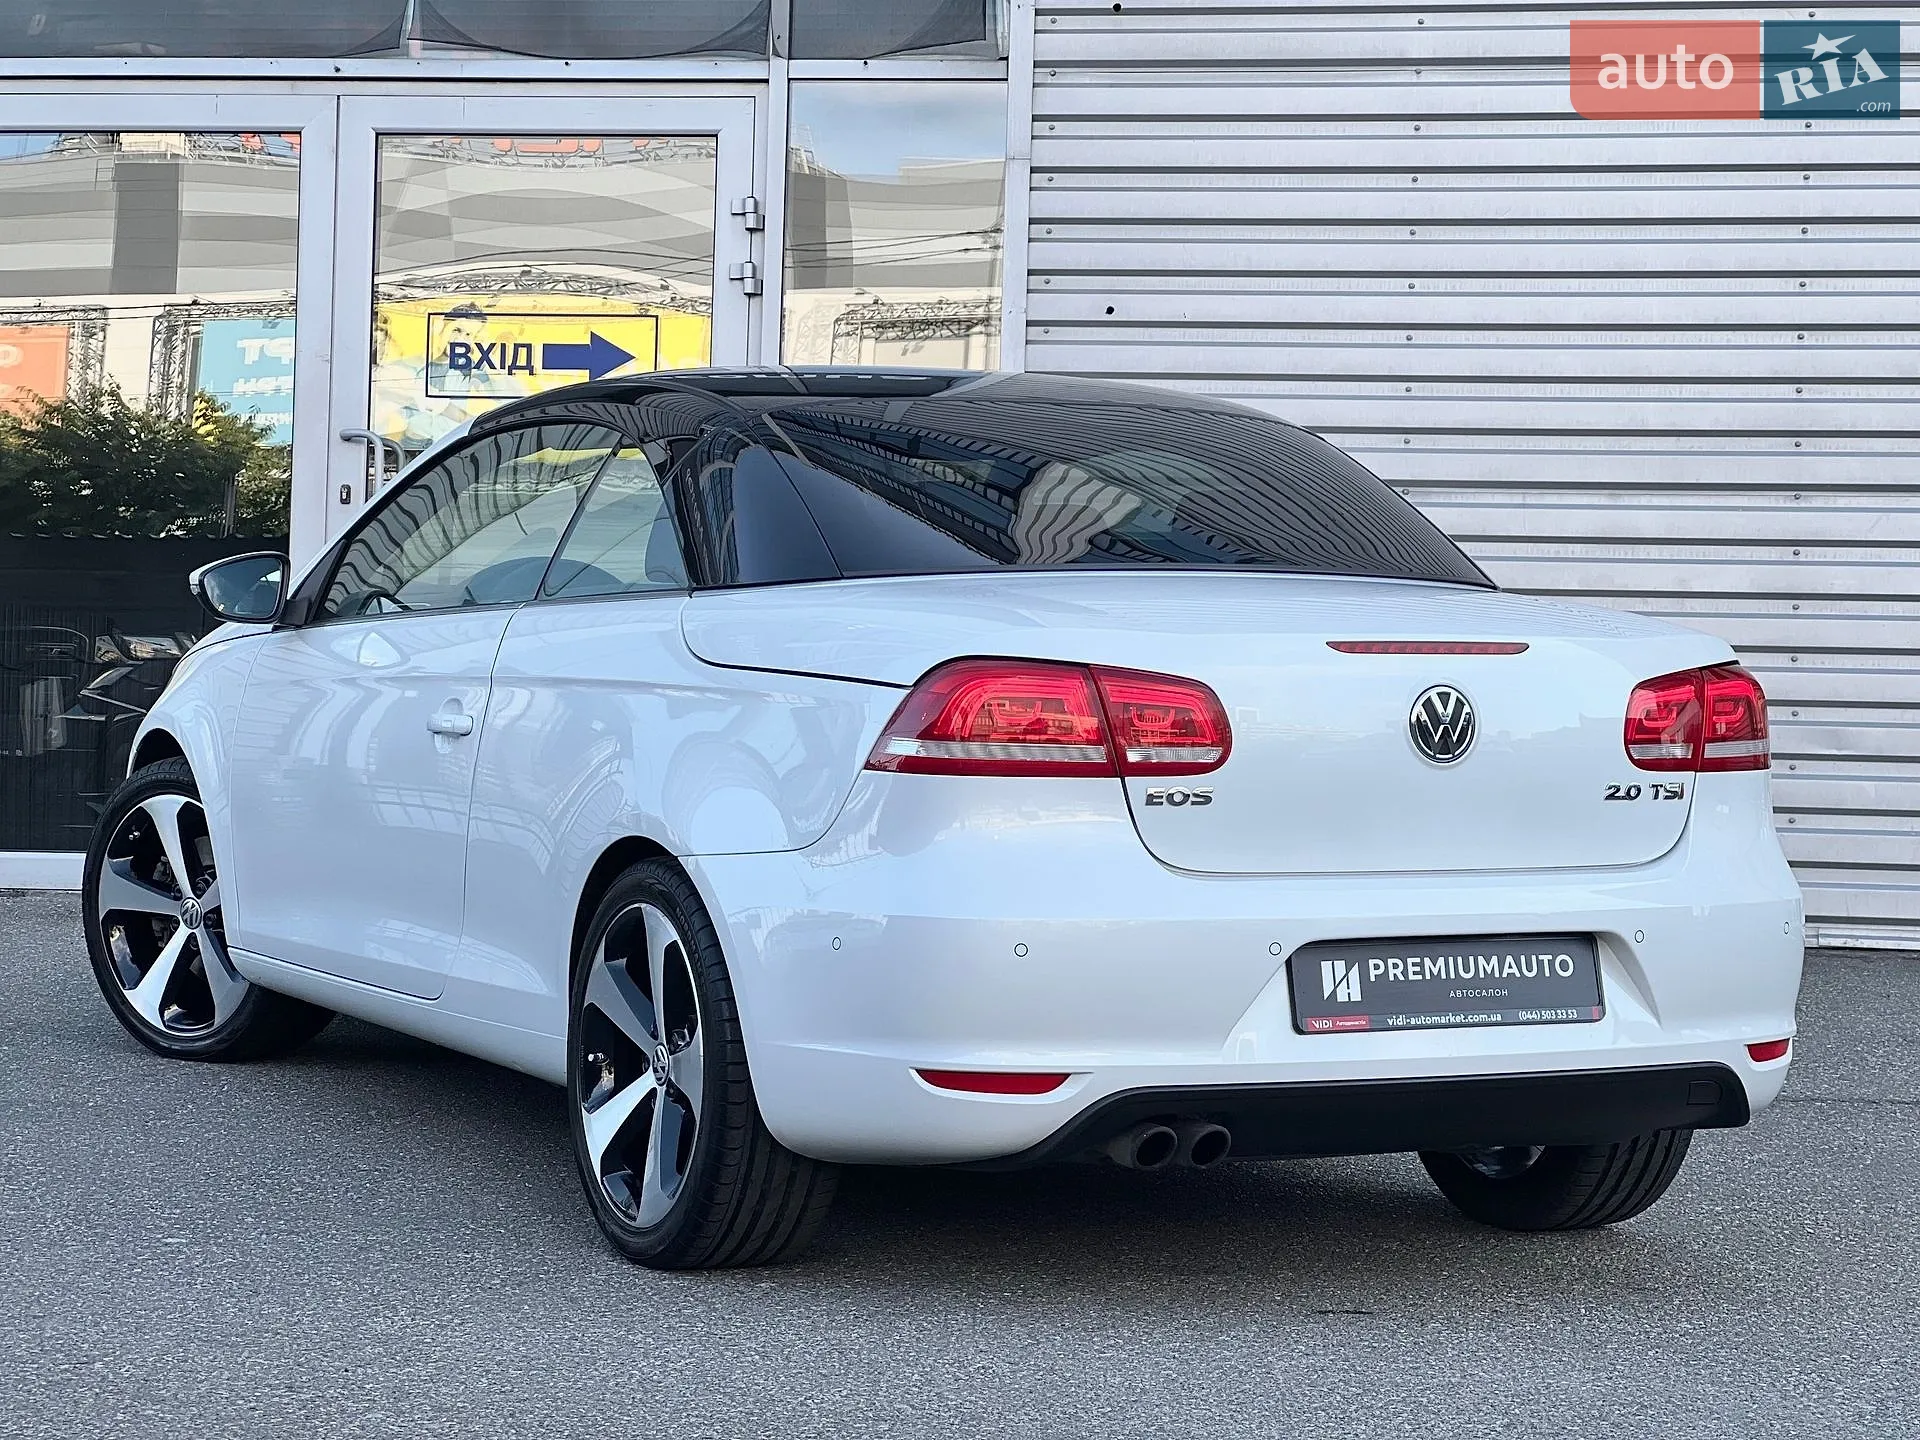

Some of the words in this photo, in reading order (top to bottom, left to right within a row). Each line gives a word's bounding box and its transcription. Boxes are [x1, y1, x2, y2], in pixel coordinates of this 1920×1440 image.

[448, 341, 535, 376] ВХІД
[1145, 786, 1215, 807] EOS
[1649, 782, 1685, 800] TSI
[1368, 954, 1575, 982] PREMIUMAUTO
[1449, 988, 1509, 999] АВТОСАЛОН
[1311, 1019, 1333, 1030] VIDI
[1387, 1012, 1503, 1027] vidi-automarket.com.ua
